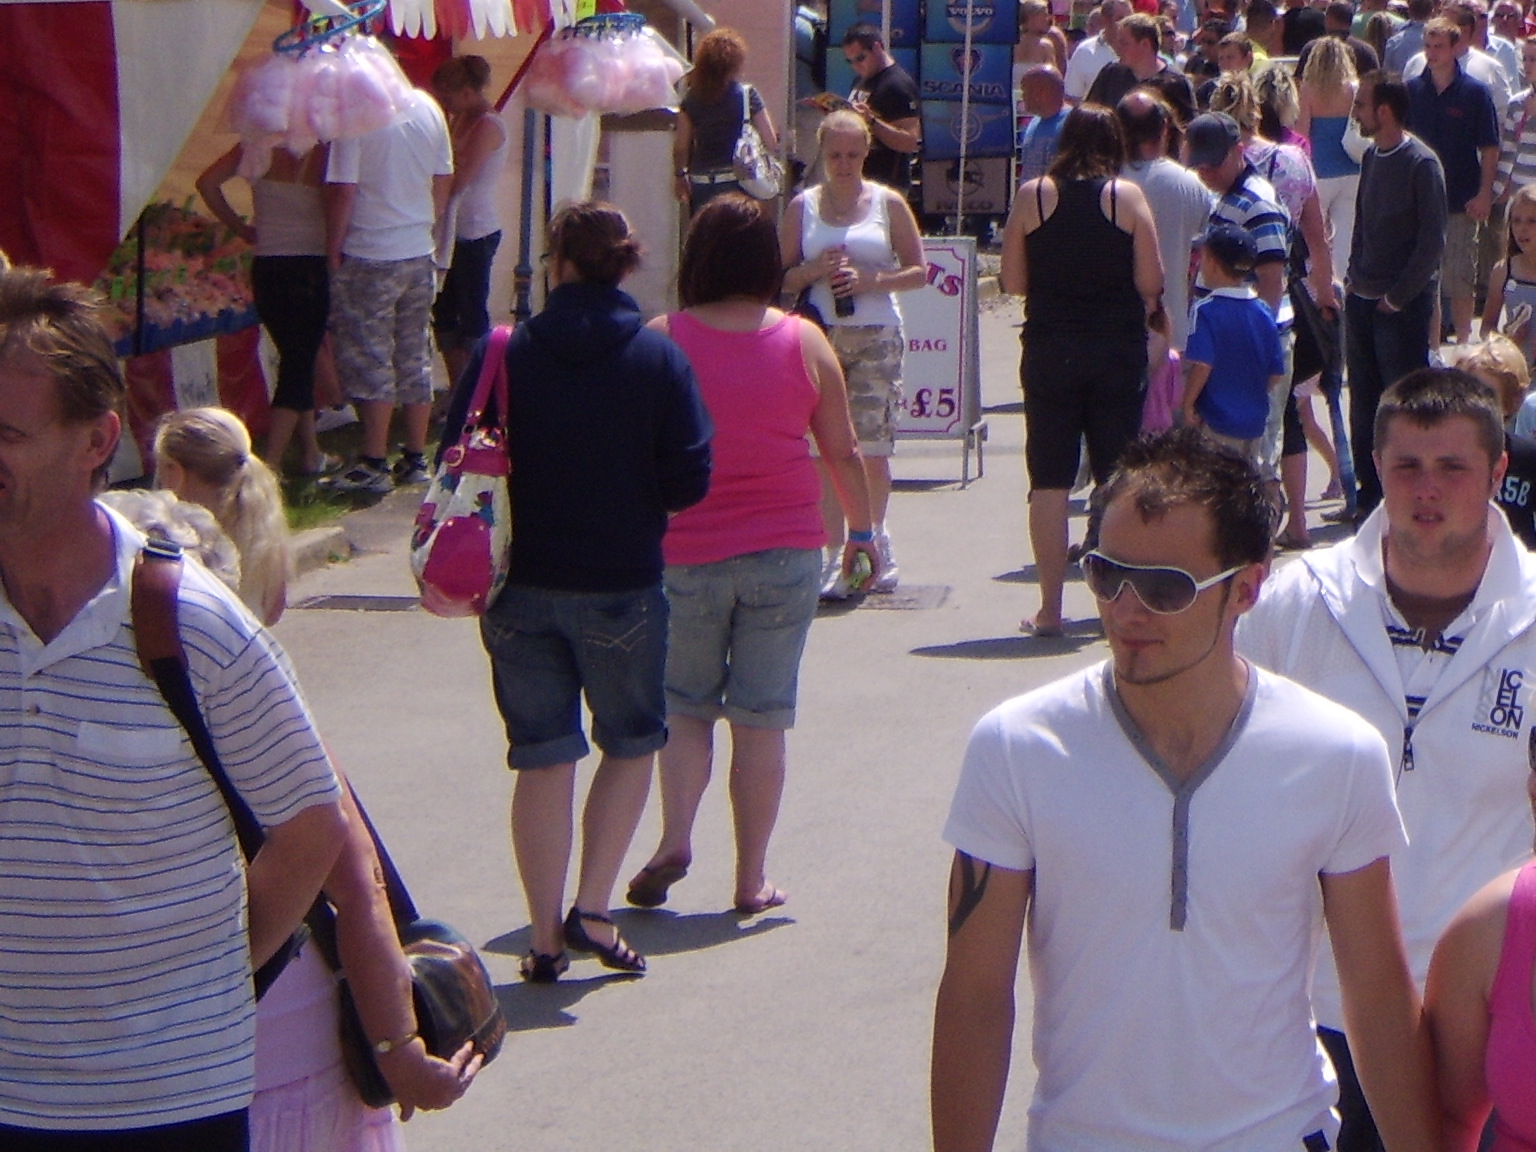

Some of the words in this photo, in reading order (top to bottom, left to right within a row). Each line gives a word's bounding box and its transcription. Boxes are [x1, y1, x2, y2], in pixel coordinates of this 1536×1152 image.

[924, 80, 1008, 98] SCANIA
[908, 338, 948, 352] BAG
[910, 388, 956, 419] £5
